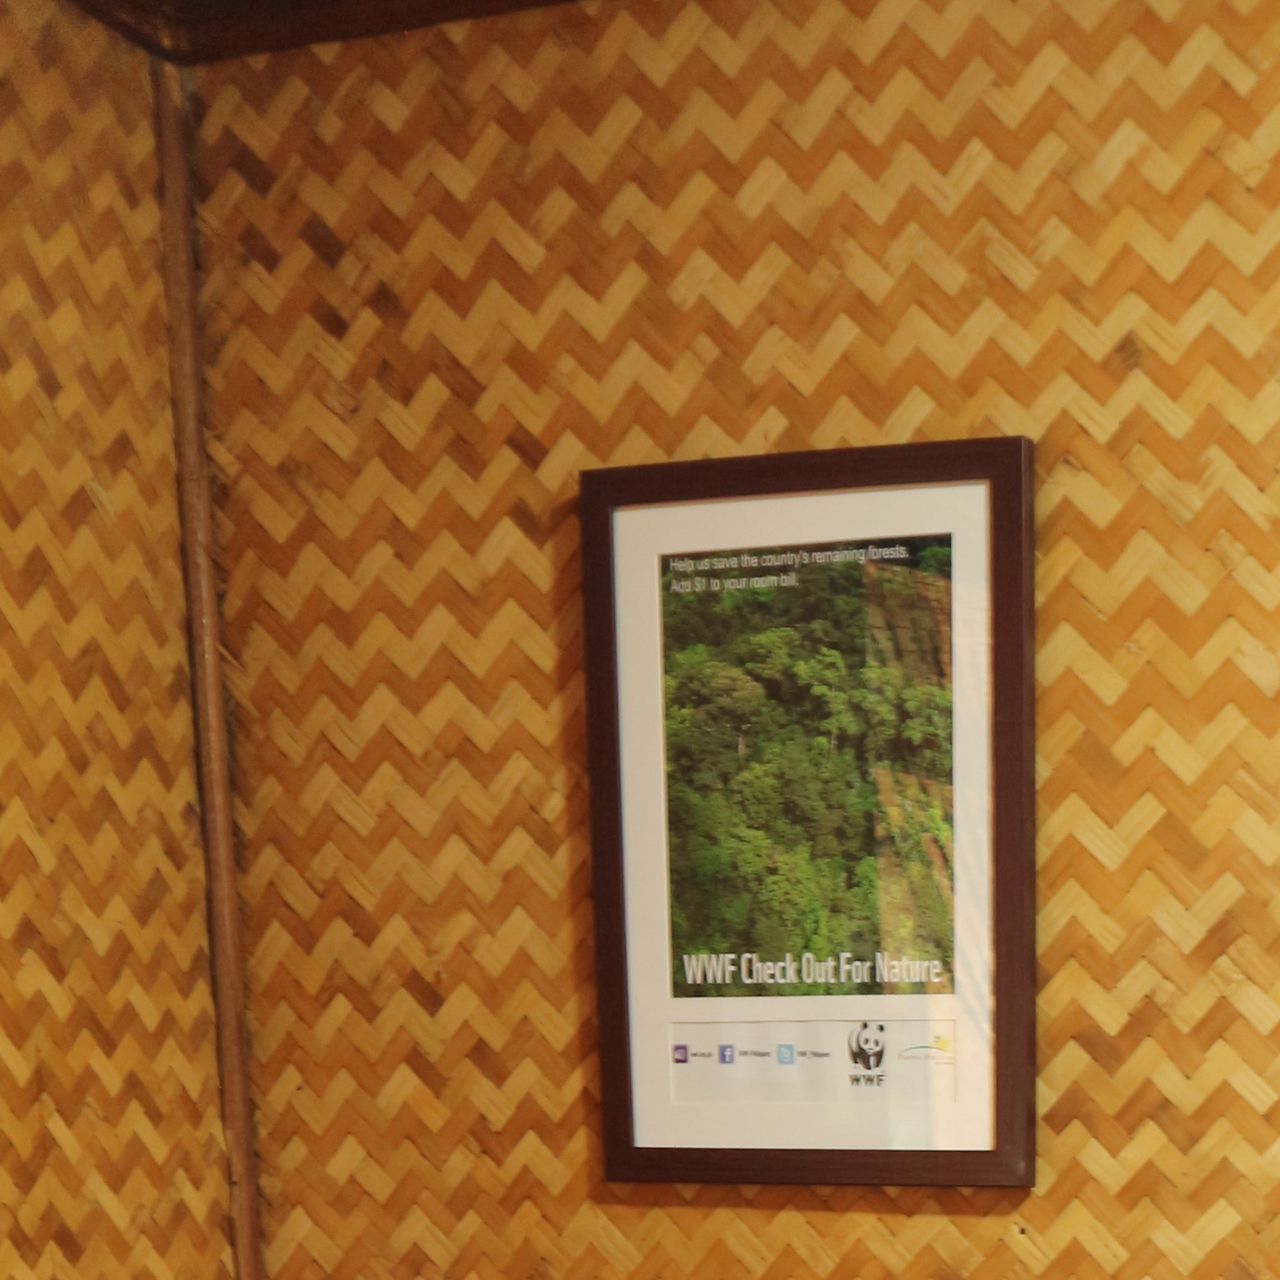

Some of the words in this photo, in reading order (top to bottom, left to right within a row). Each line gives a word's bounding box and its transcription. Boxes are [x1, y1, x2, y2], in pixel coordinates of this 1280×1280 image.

[670, 558, 694, 573] Help
[696, 558, 710, 570] us
[712, 556, 738, 569] save
[741, 554, 758, 567] the
[761, 550, 809, 568] country's
[812, 547, 865, 564] remaining
[868, 545, 909, 559] forests.
[670, 579, 691, 592] Add
[710, 577, 720, 590] to
[723, 577, 747, 592] your
[750, 575, 777, 588] room
[683, 953, 737, 984] WWF
[740, 953, 799, 983] Check
[801, 952, 836, 983] Out
[839, 952, 872, 983] For
[875, 951, 943, 983] Nature
[848, 1074, 886, 1087] WWF
